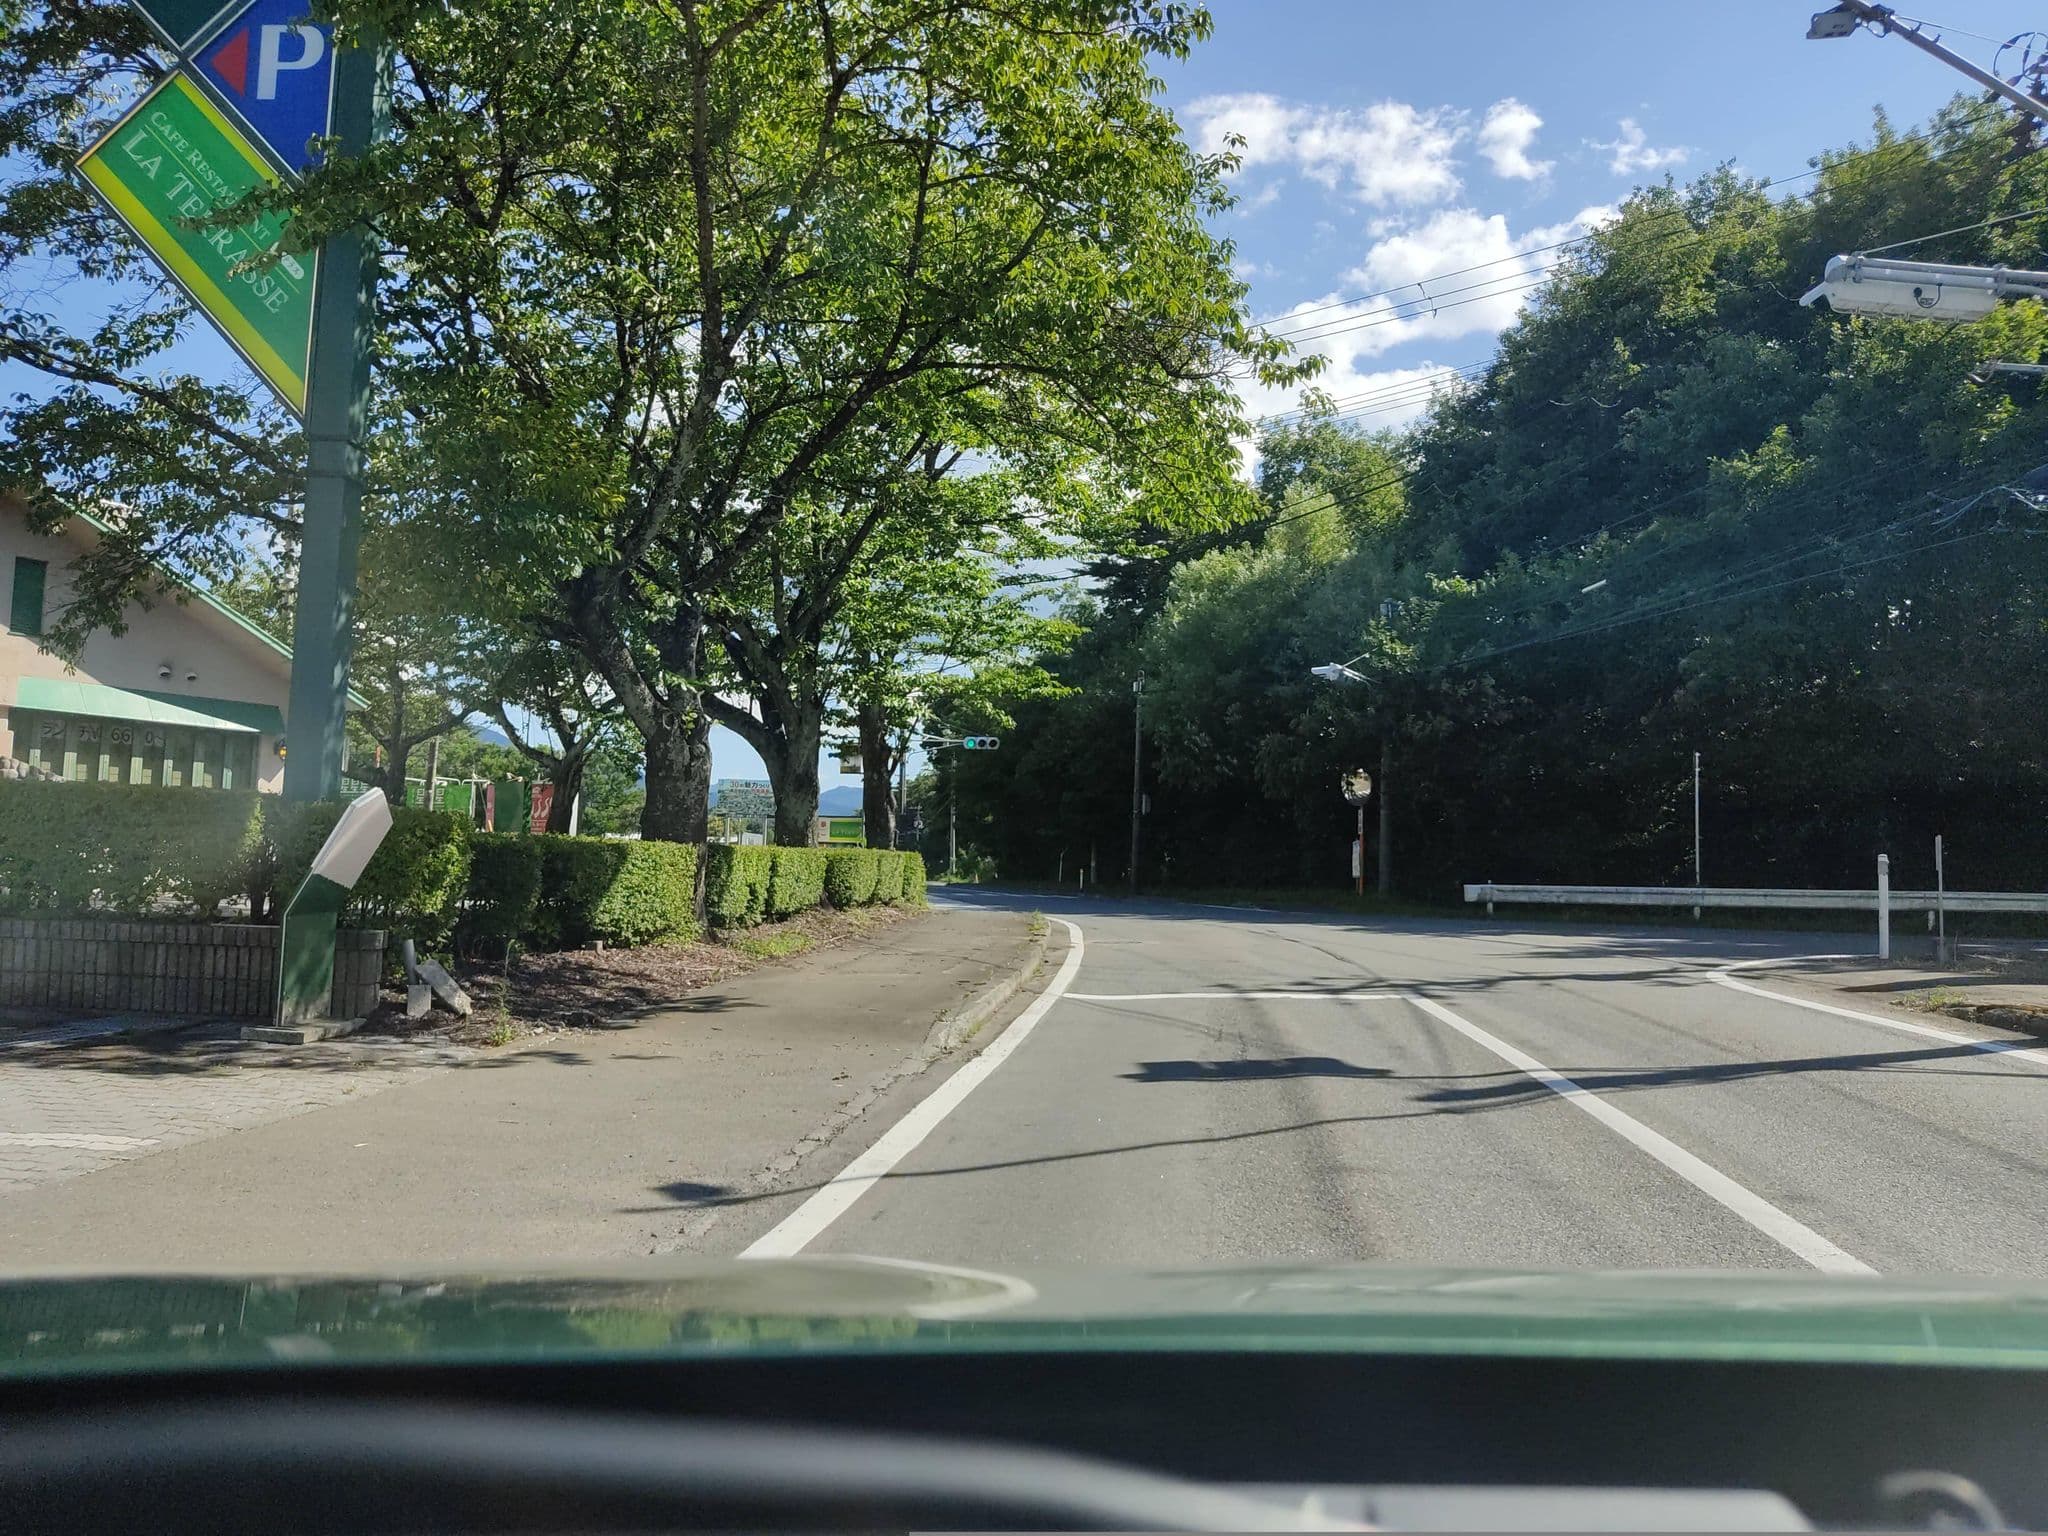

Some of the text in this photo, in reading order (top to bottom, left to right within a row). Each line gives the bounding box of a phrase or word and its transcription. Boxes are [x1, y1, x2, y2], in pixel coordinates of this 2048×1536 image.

[256, 24, 325, 100] P
[121, 129, 162, 180] LA
[151, 111, 190, 152] CAFE
